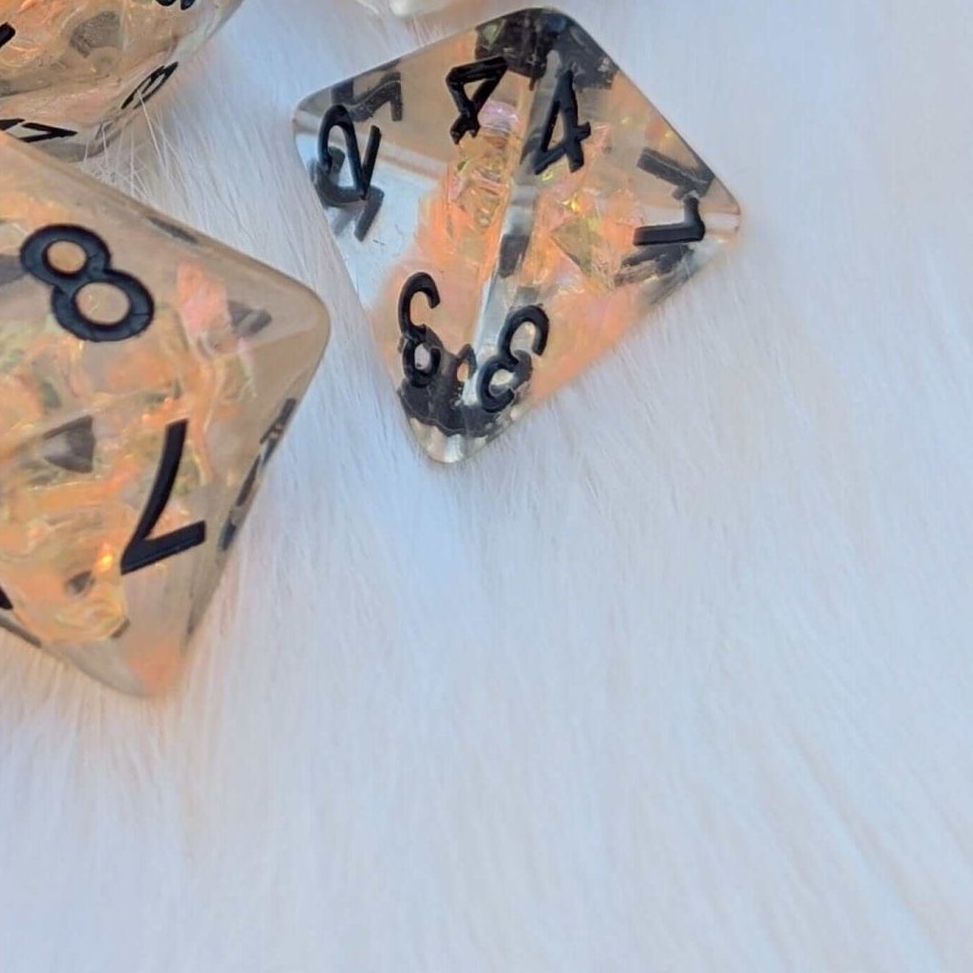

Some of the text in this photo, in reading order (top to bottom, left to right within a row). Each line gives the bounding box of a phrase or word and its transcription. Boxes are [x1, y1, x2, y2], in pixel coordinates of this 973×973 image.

[533, 69, 592, 175] 4
[20, 223, 154, 342] 8
[121, 418, 206, 576] 7
